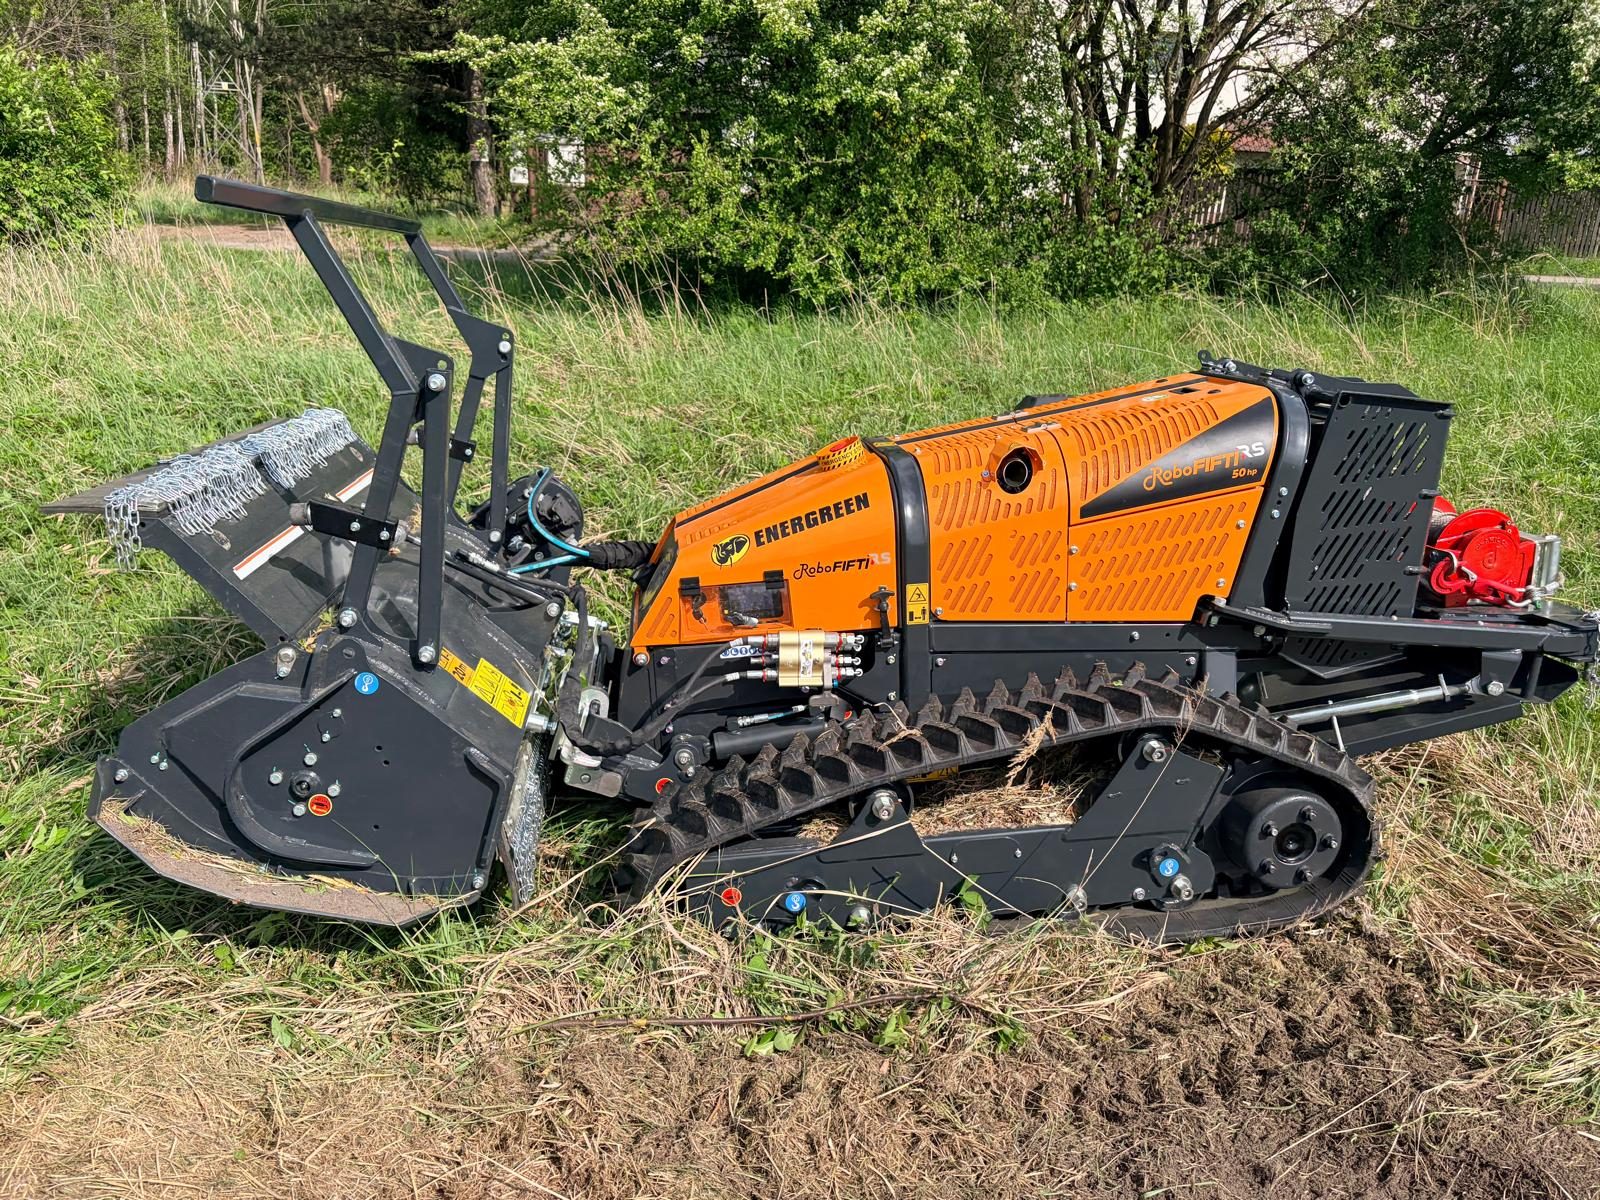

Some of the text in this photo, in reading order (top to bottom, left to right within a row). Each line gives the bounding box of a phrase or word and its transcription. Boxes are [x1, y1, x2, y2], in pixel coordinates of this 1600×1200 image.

[1231, 468, 1258, 479] 50 hp
[754, 492, 870, 548] ENERGREEN
